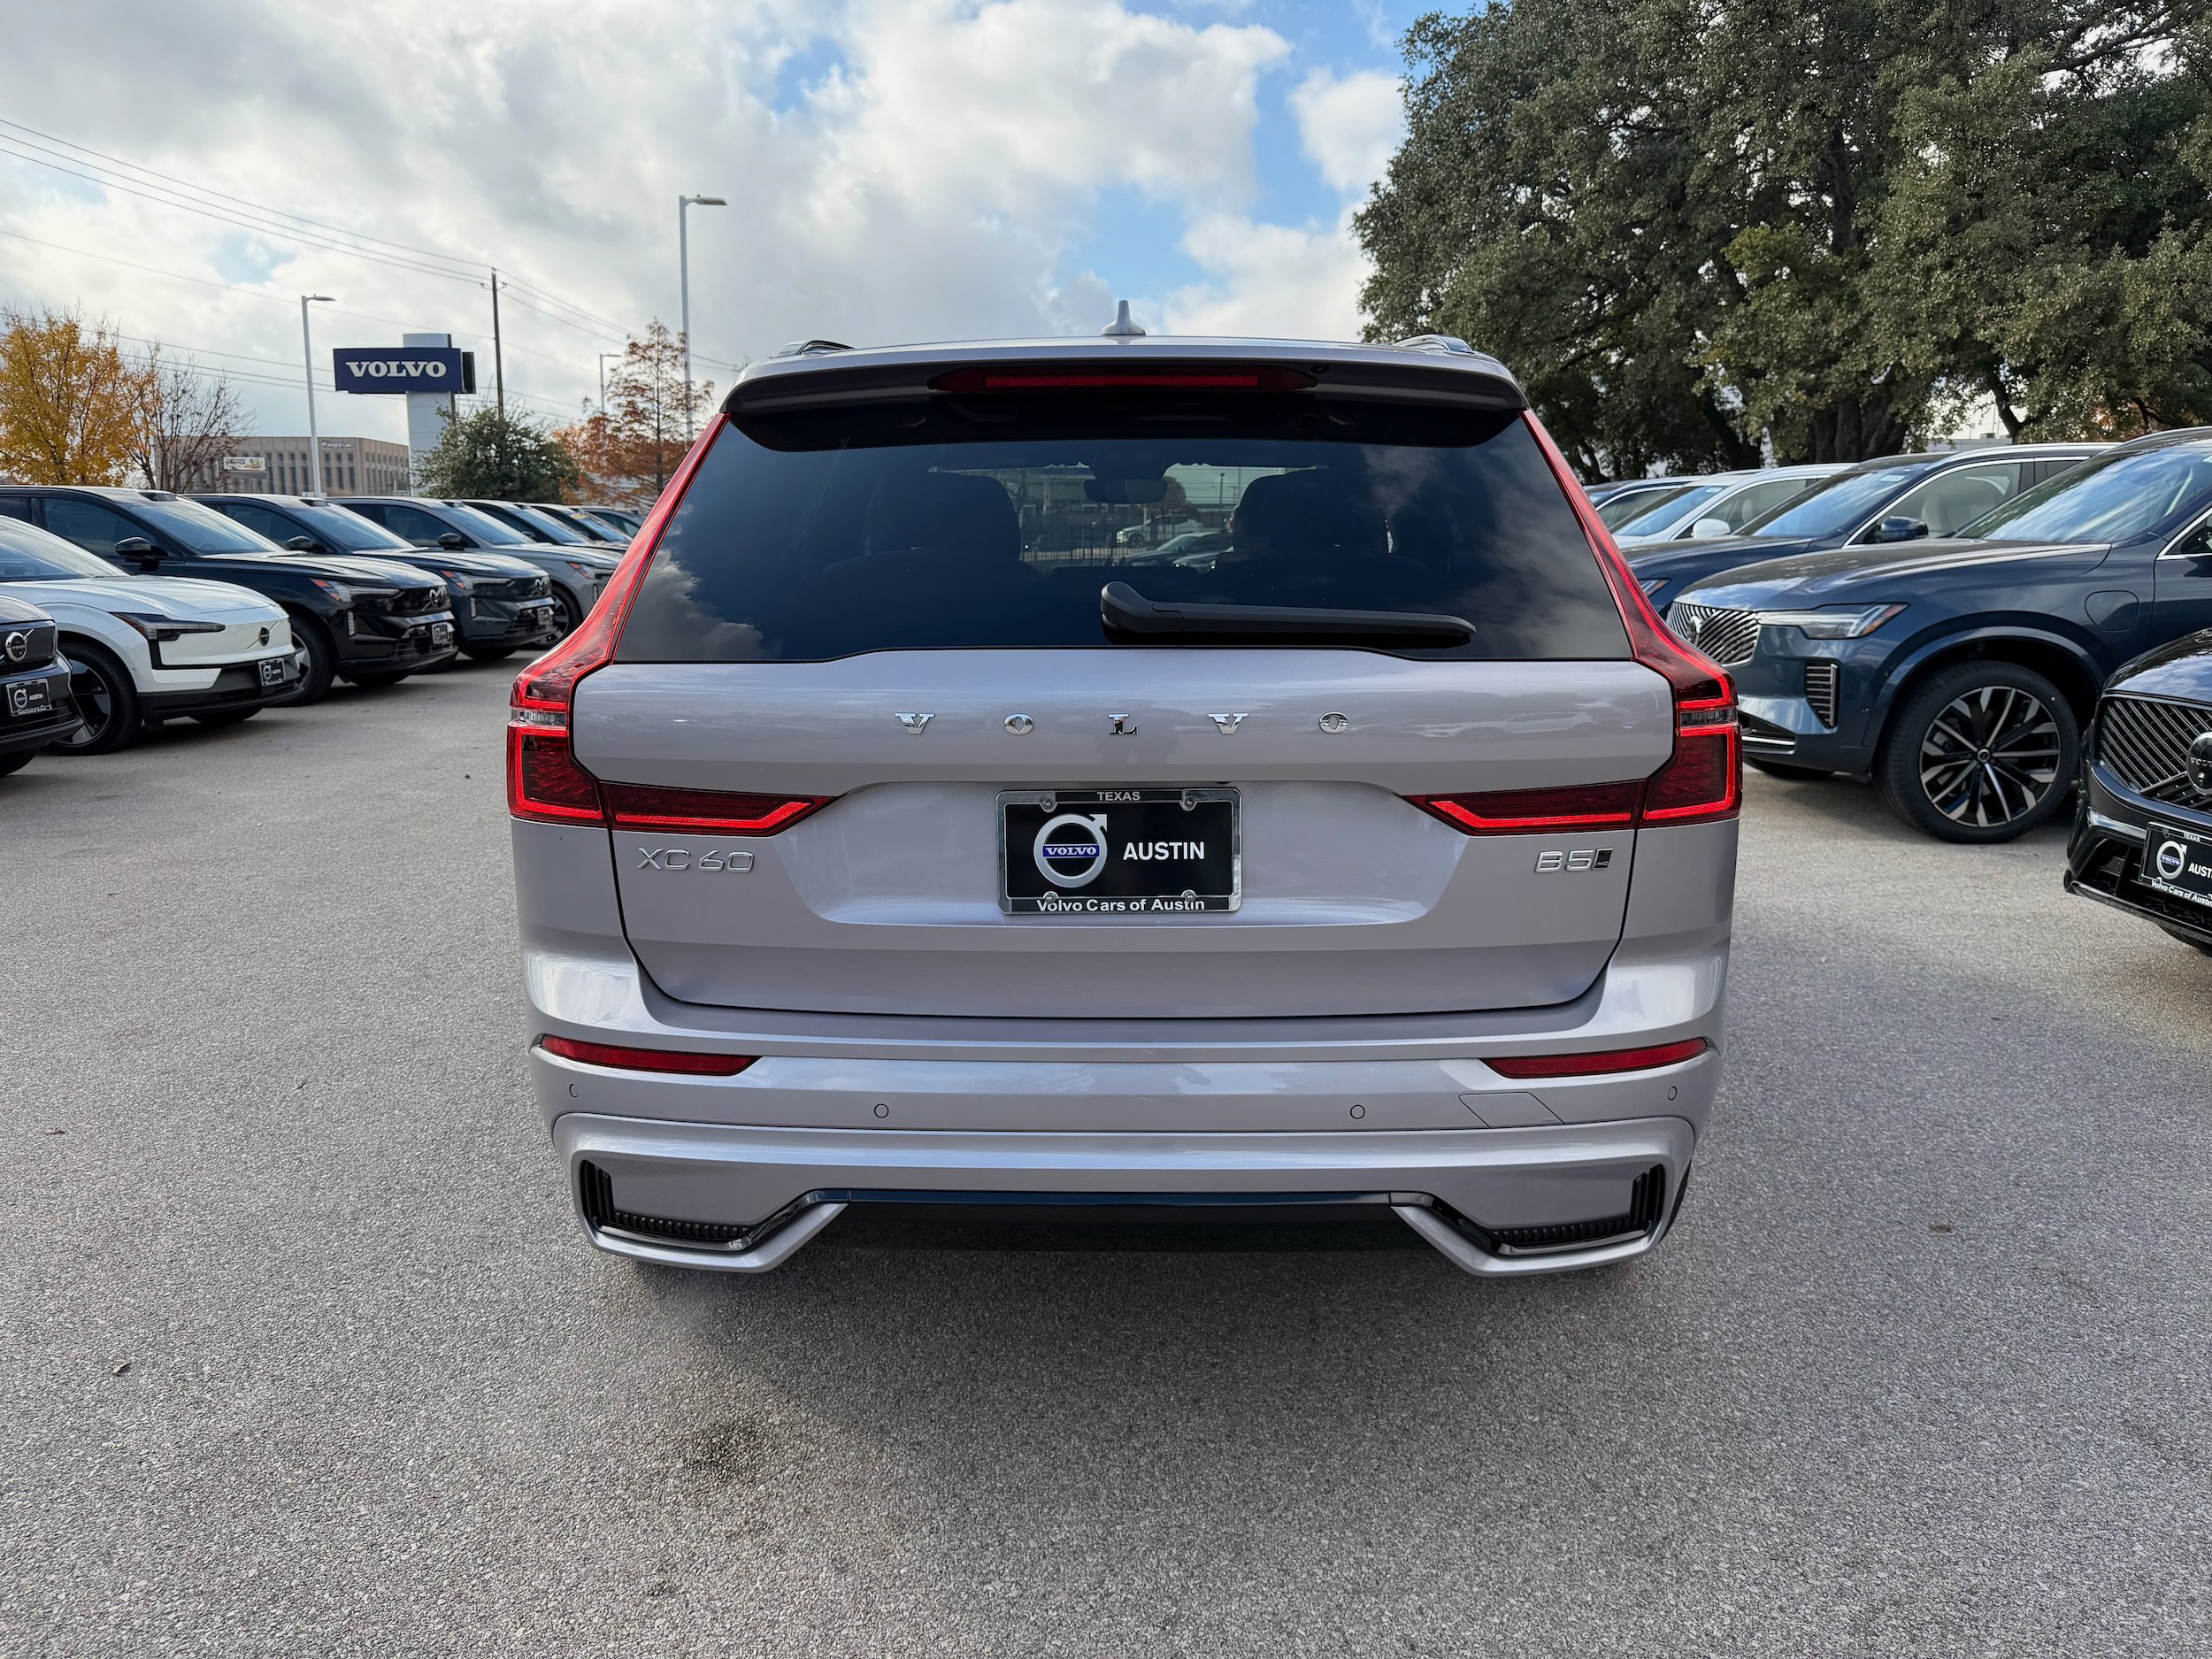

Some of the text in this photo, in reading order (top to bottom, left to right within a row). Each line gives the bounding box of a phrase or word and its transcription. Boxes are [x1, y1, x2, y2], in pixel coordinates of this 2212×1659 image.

[345, 360, 447, 378] VOLVO
[895, 710, 1349, 735] VOLVO
[1096, 791, 1141, 802] TEXAS
[2183, 833, 2200, 842] TEXAS
[1045, 847, 1097, 856] VOLVO
[1122, 841, 1205, 861] AUSTIN
[1534, 850, 1594, 872] B5
[2162, 856, 2180, 865] VOLVO
[2188, 862, 2212, 879] AUST
[2151, 879, 2168, 892] Volvo
[2169, 886, 2184, 897] Cars
[1037, 898, 1205, 912] Volvo Cars of Austin
